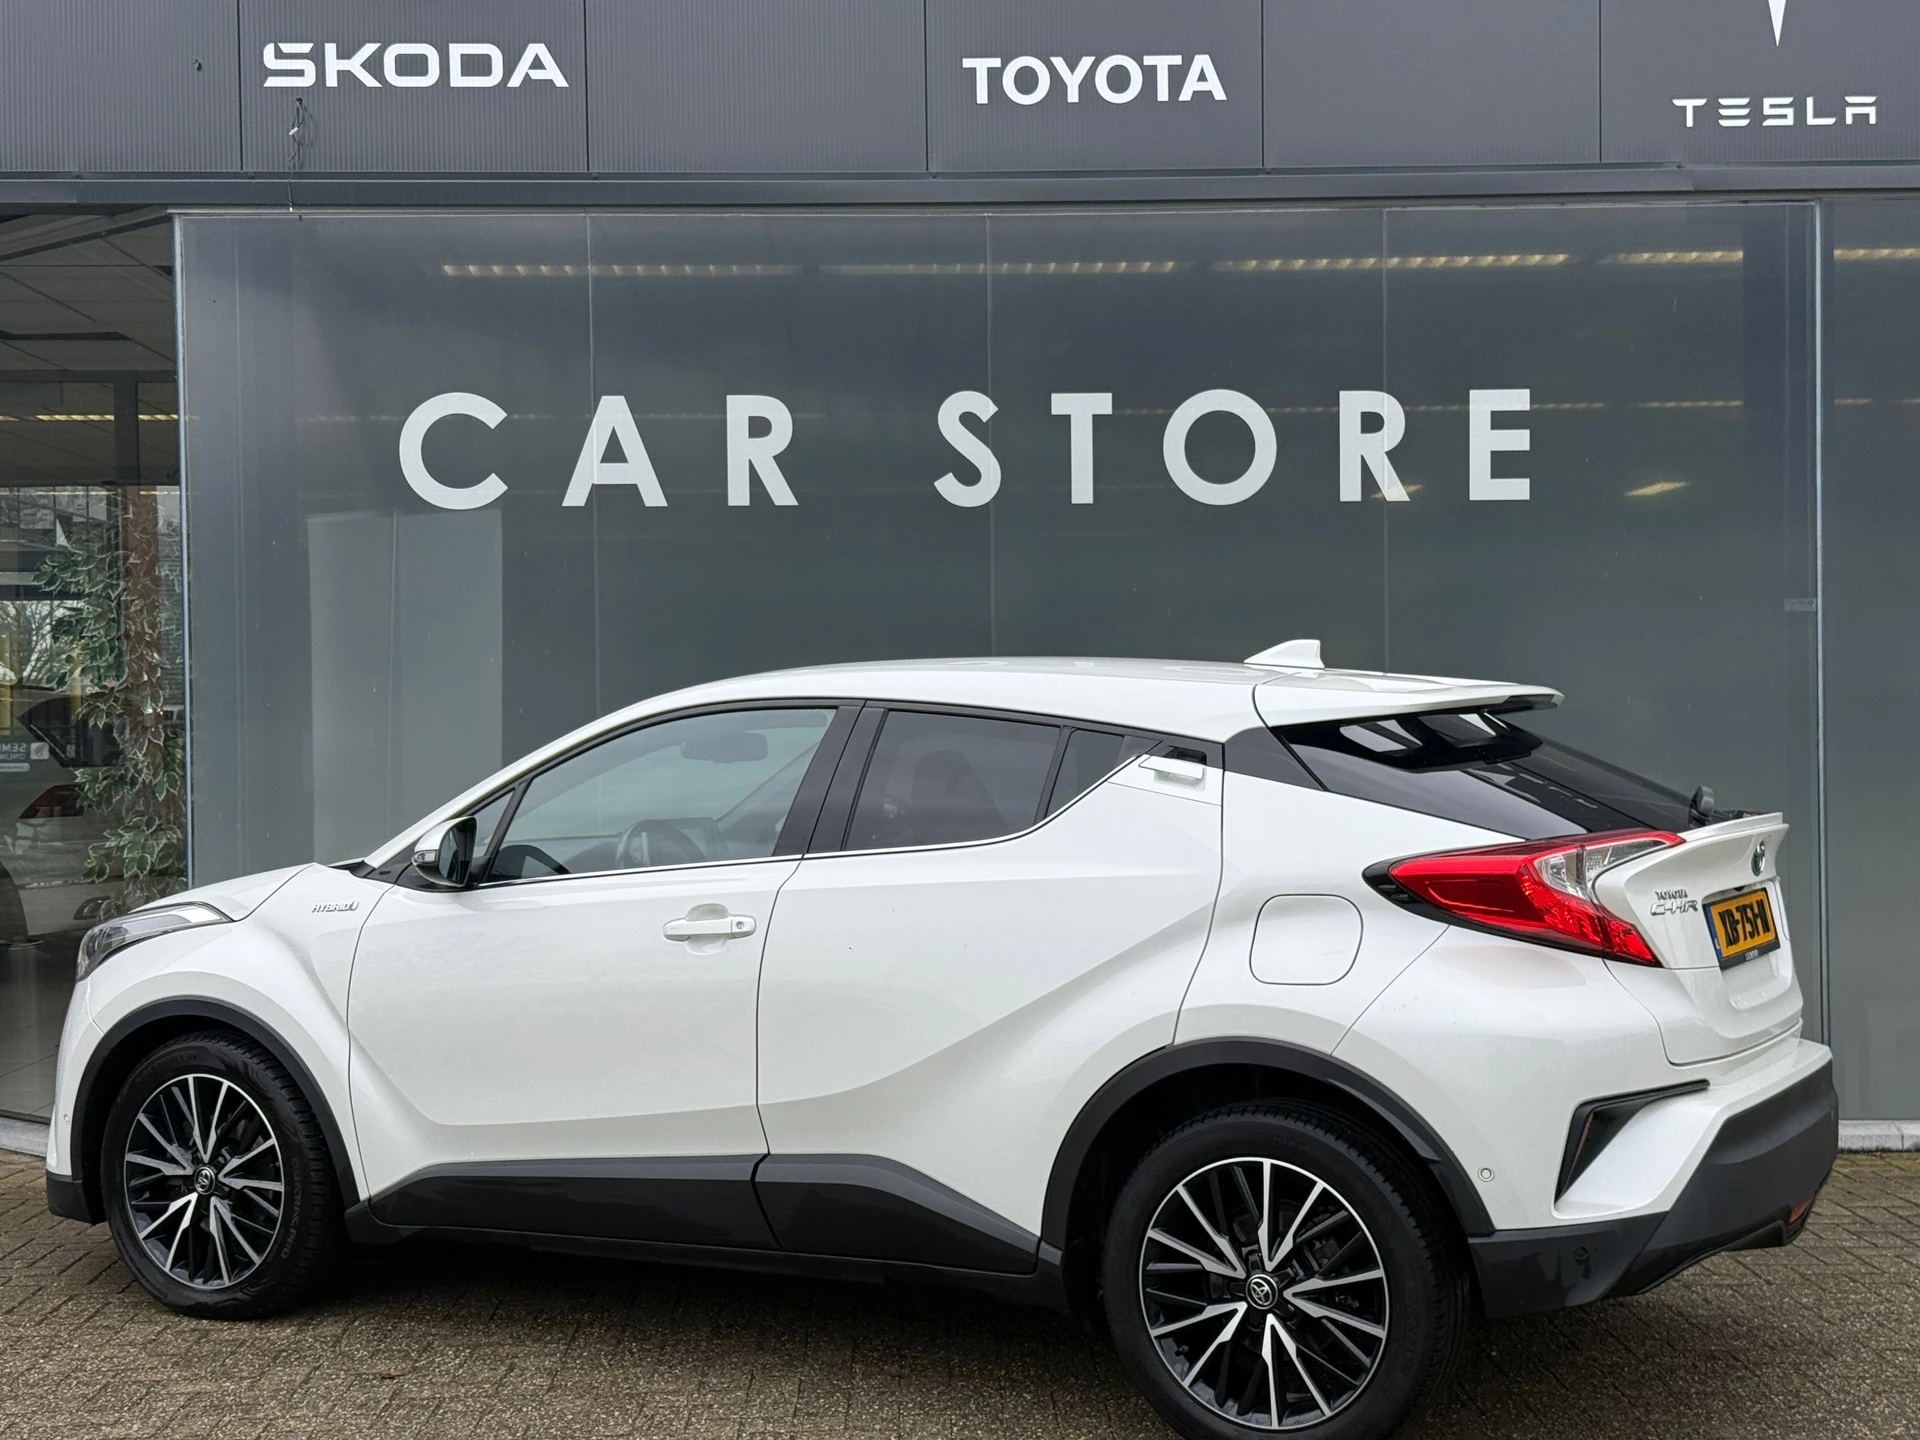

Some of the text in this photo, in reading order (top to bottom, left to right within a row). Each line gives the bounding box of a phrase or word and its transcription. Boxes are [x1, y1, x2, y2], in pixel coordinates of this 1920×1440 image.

[962, 55, 1227, 105] TOYOTA
[1672, 96, 1876, 127] TESLA
[399, 388, 1532, 510] CAR STORE
[311, 902, 352, 913] HYBRID
[1650, 900, 1698, 916] C-HR
